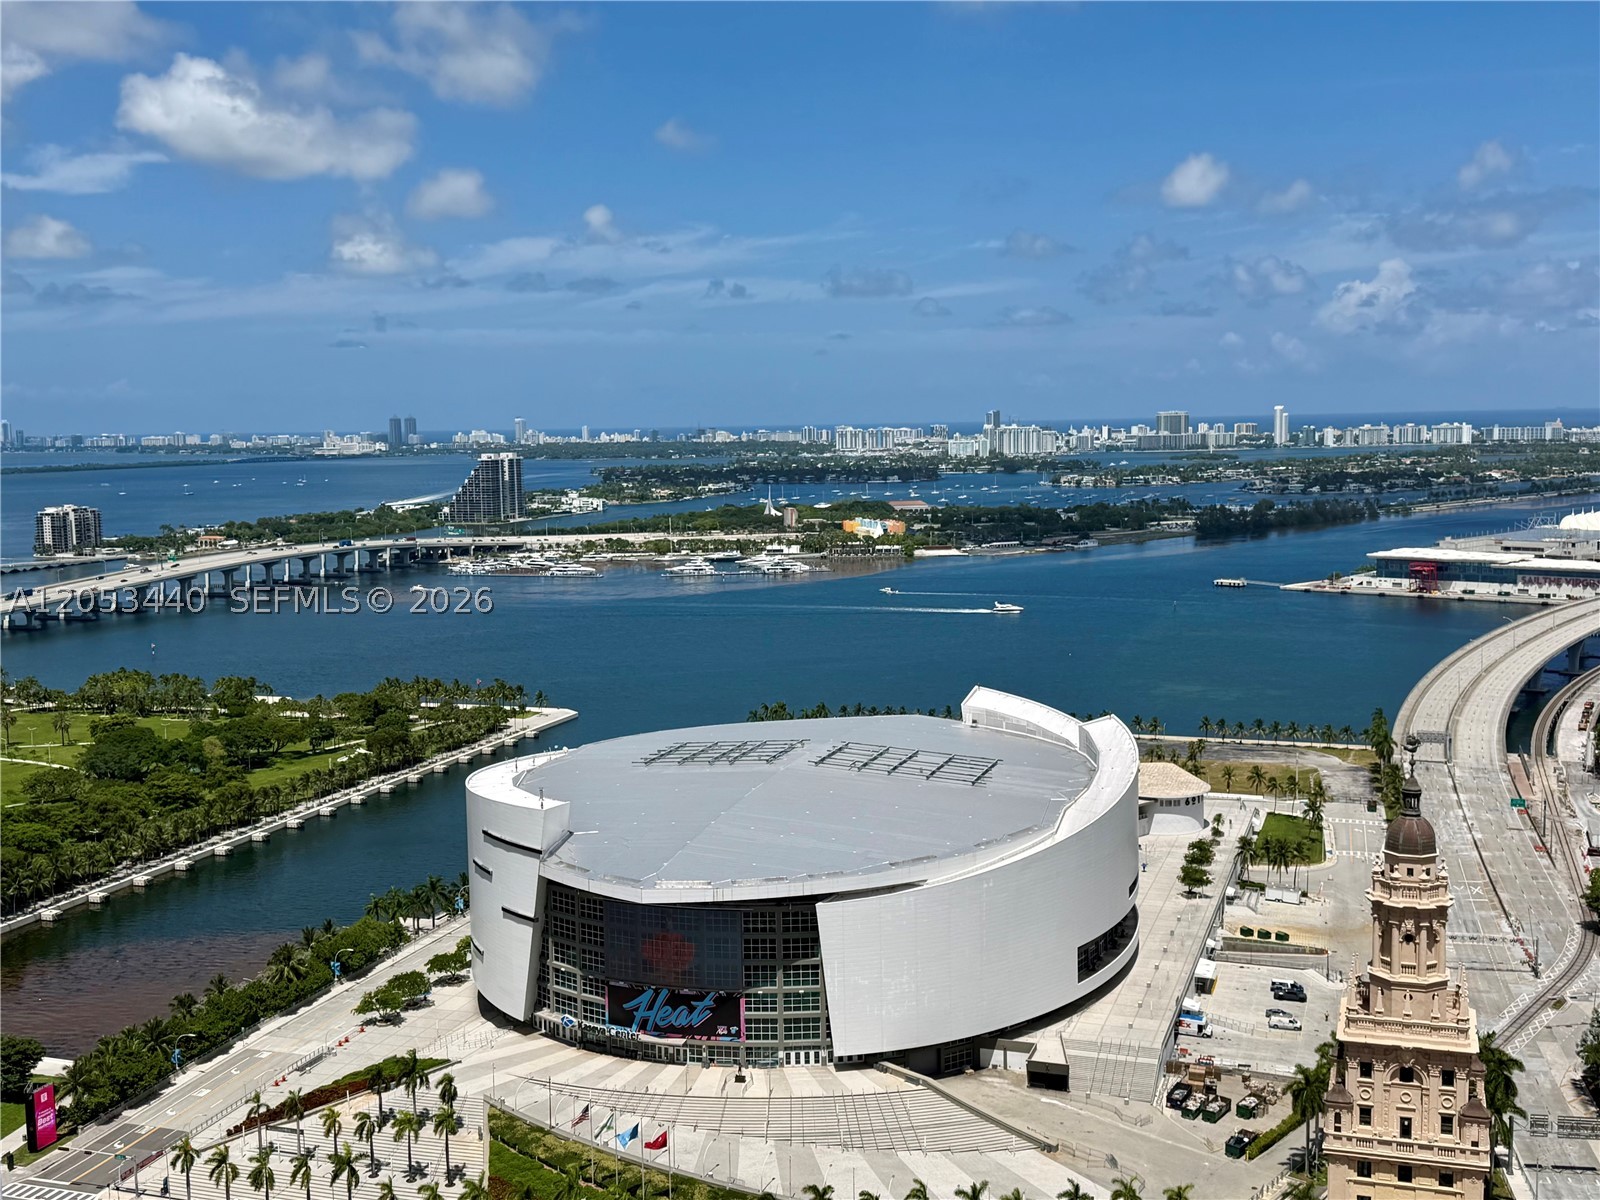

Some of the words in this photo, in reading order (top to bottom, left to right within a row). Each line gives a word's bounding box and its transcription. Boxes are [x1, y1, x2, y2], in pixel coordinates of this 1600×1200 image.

[1520, 576, 1541, 585] SAIL
[1542, 576, 1563, 586] THE
[1185, 795, 1200, 805] 601
[622, 987, 719, 1033] Heat
[577, 1019, 606, 1036] Kaseya
